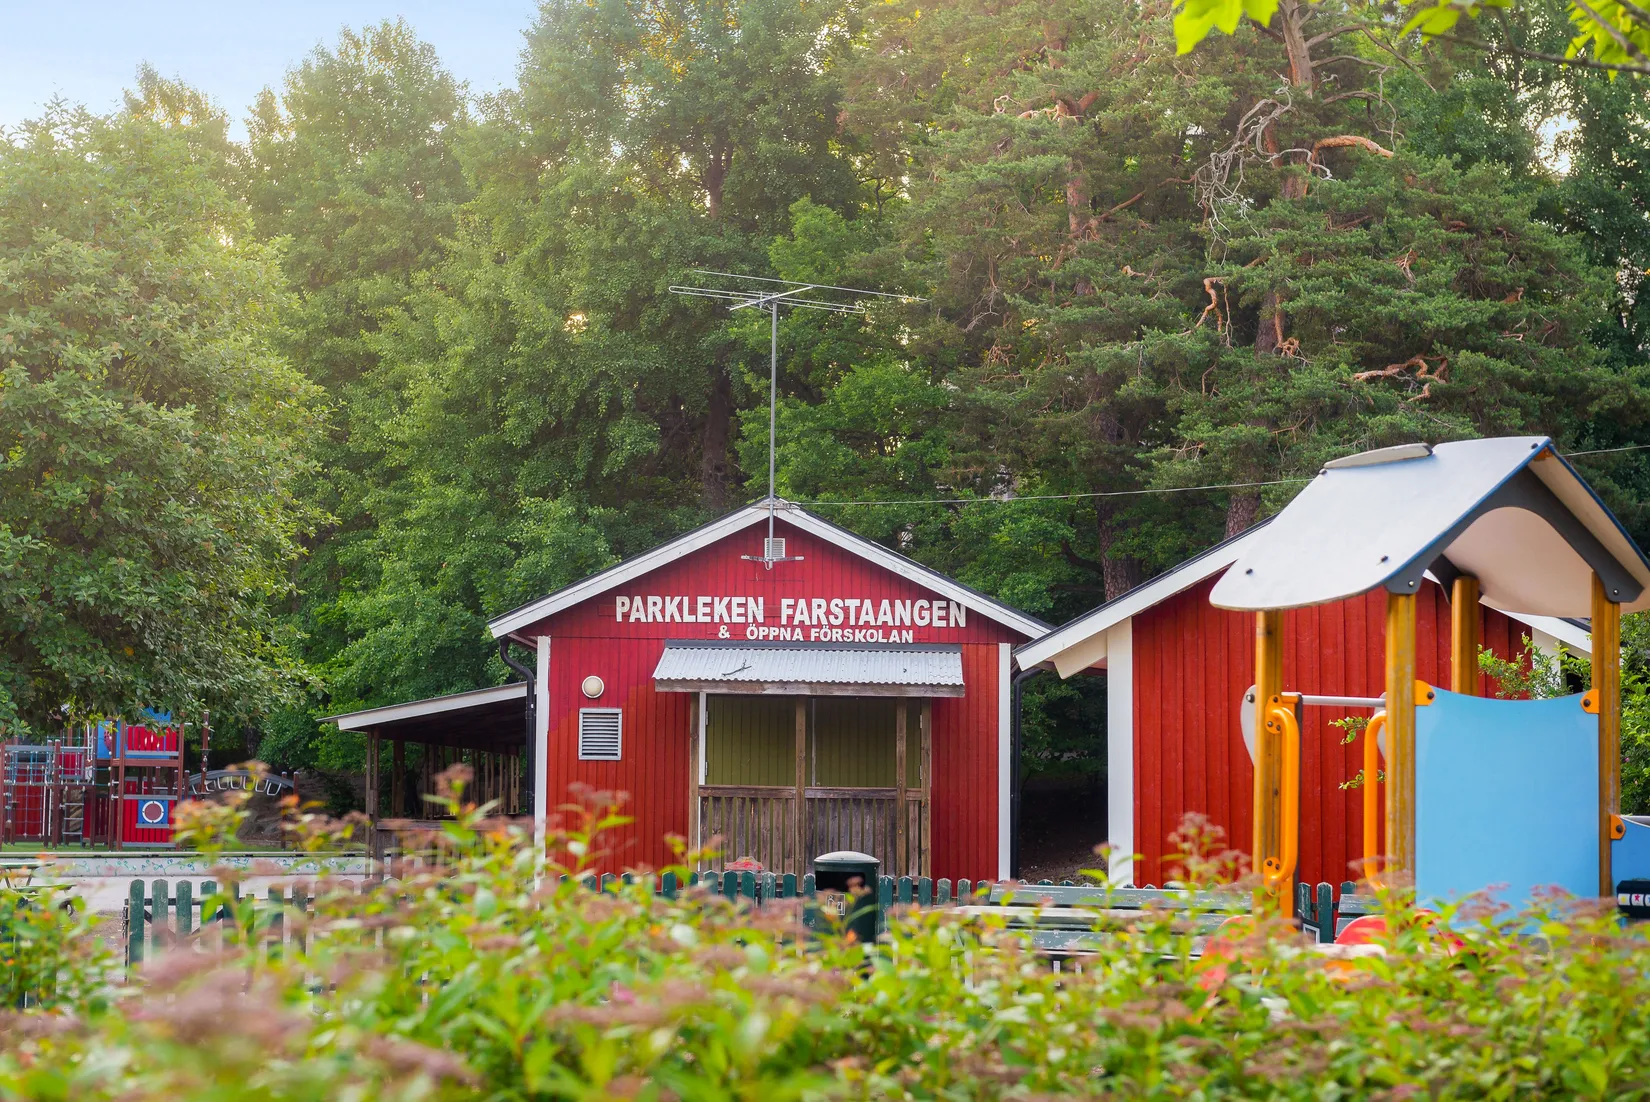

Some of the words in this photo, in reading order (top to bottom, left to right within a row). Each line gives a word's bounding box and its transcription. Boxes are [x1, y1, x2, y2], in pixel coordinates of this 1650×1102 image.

[615, 595, 764, 623] PARKLEKEN
[781, 598, 966, 627] FARSTAANGEN
[718, 625, 731, 639] &
[746, 624, 804, 641] ÖPPNA
[811, 625, 913, 643] FÖRSKOLAN
